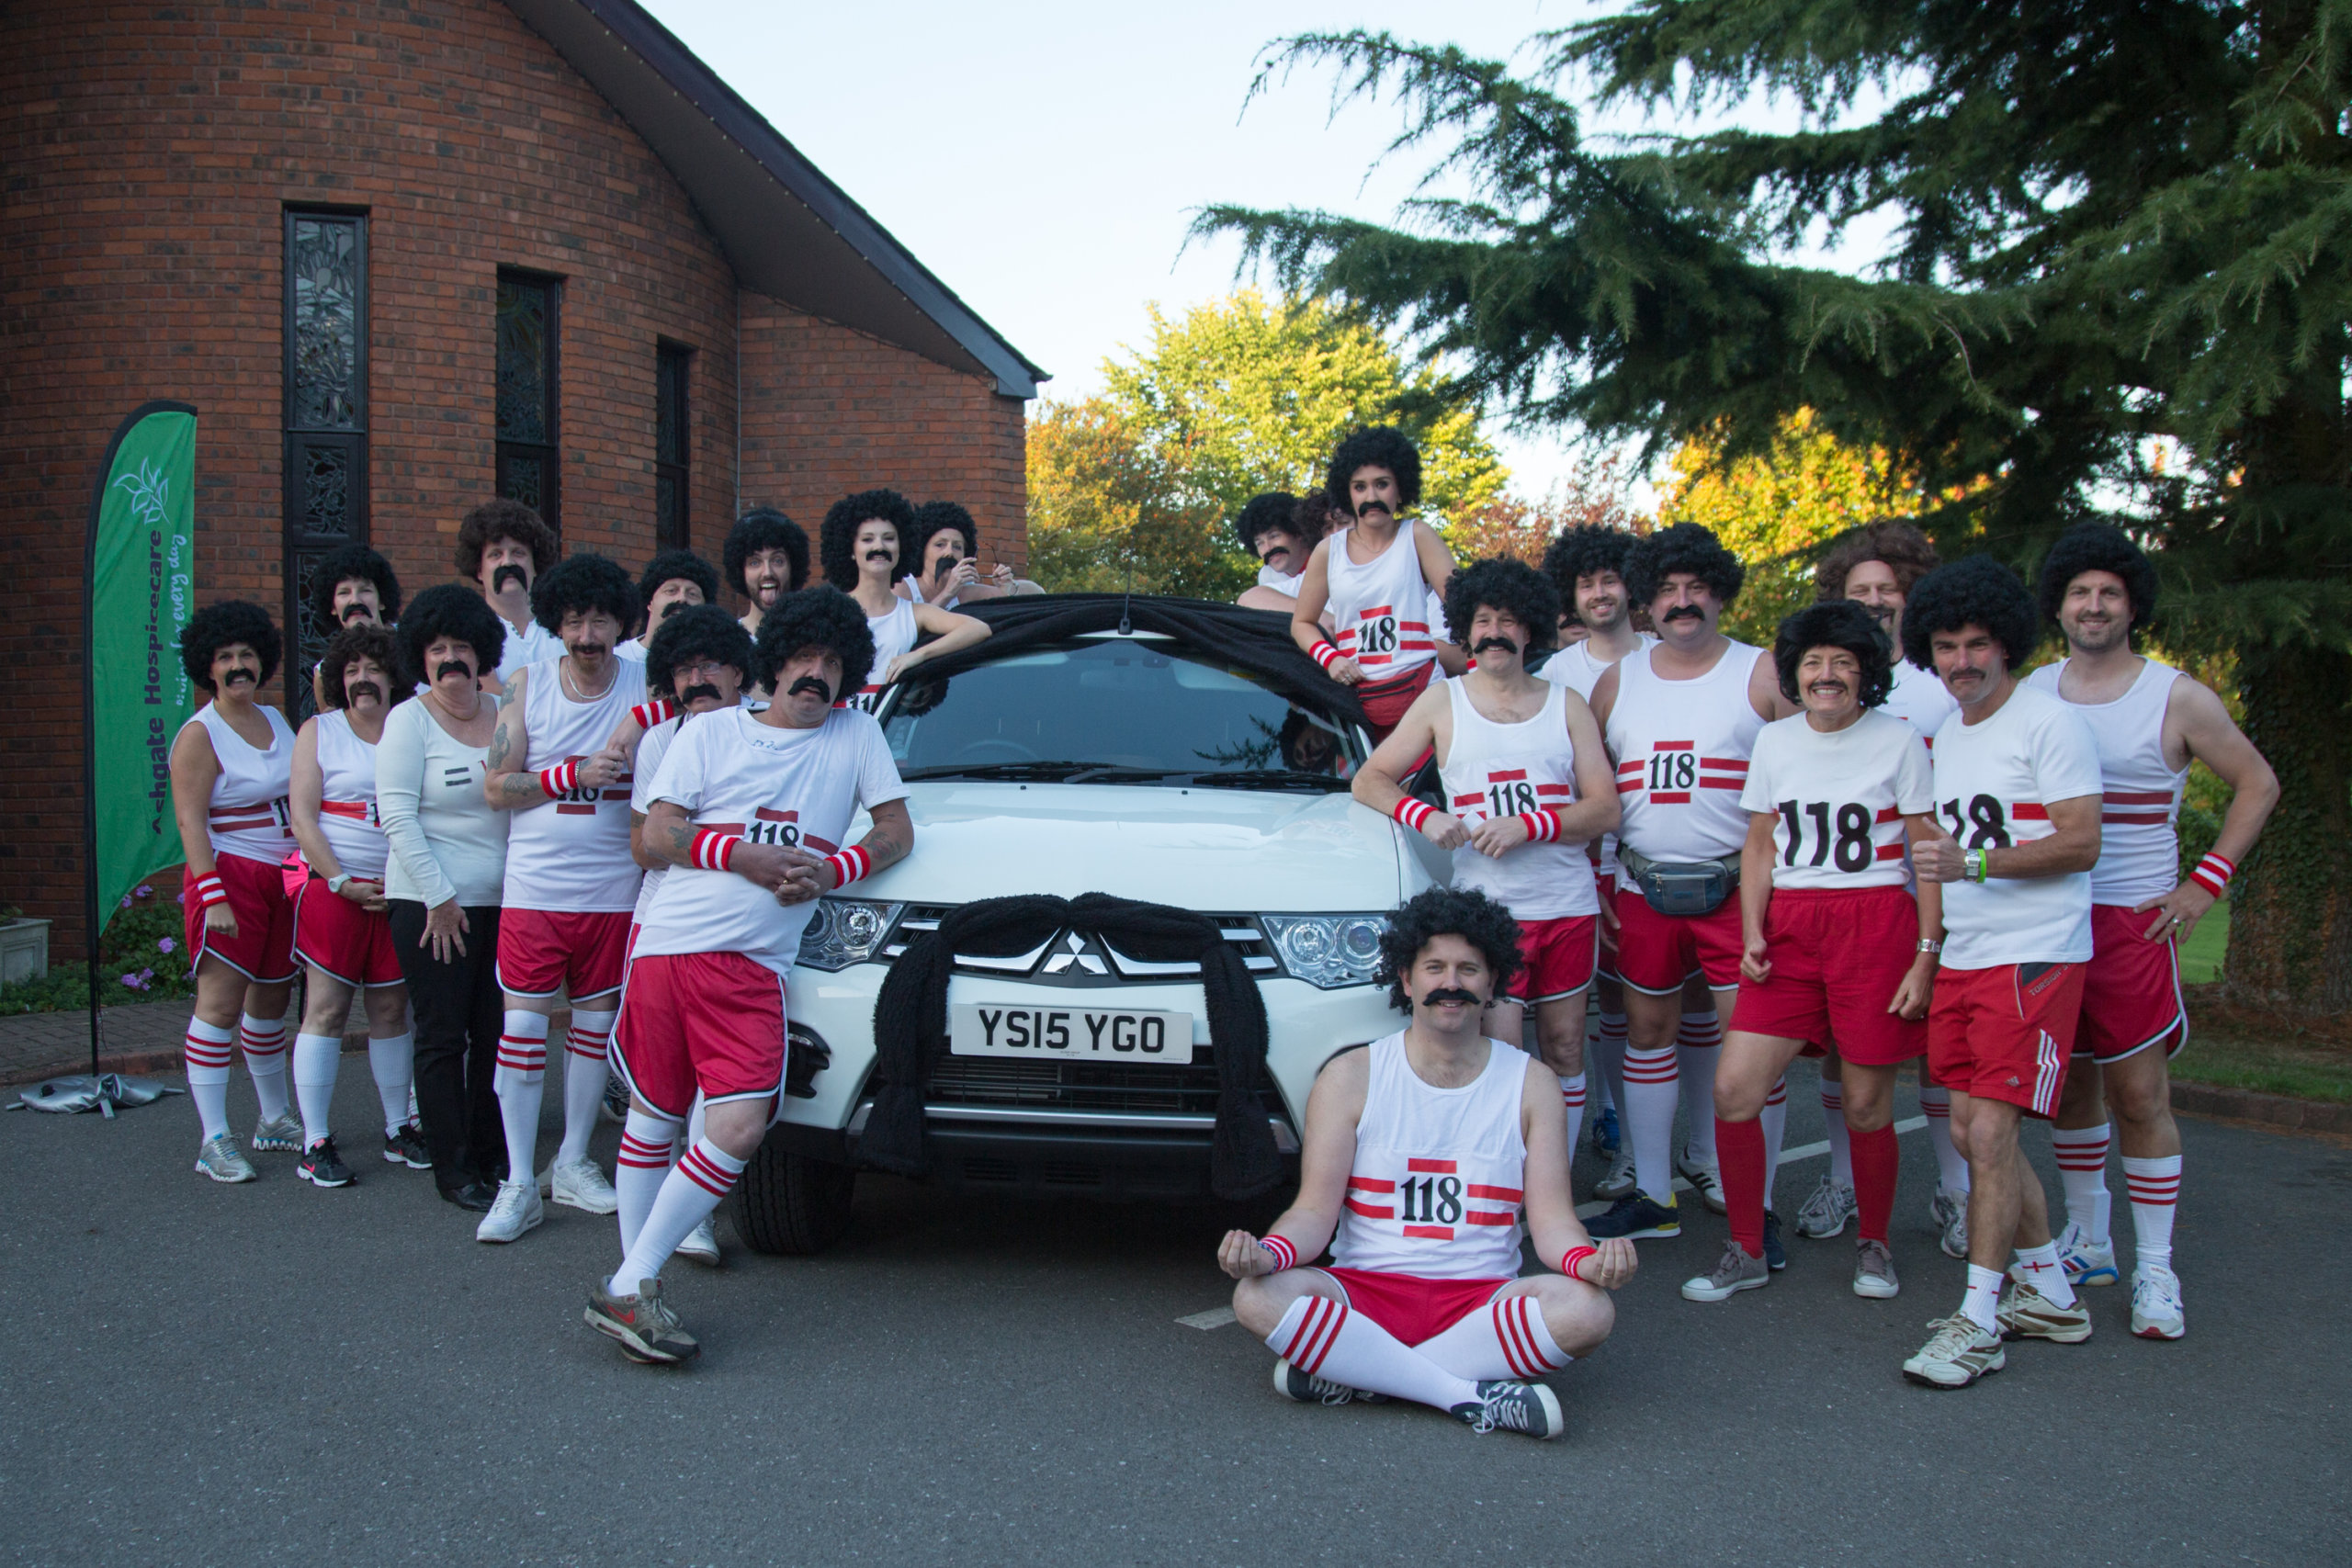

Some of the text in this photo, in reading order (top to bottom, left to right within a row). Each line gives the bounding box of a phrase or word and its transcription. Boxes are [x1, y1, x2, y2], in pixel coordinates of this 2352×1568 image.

[167, 534, 187, 569] day
[143, 530, 164, 705] Hospicecare
[170, 573, 189, 621] every
[1358, 616, 1397, 653] 118
[1648, 752, 1696, 790] 118
[1488, 782, 1537, 818] 118
[750, 821, 800, 848] 118
[1778, 799, 1873, 874] 118
[978, 1009, 1166, 1054] YS15 YGO
[1400, 1176, 1463, 1224] 118
